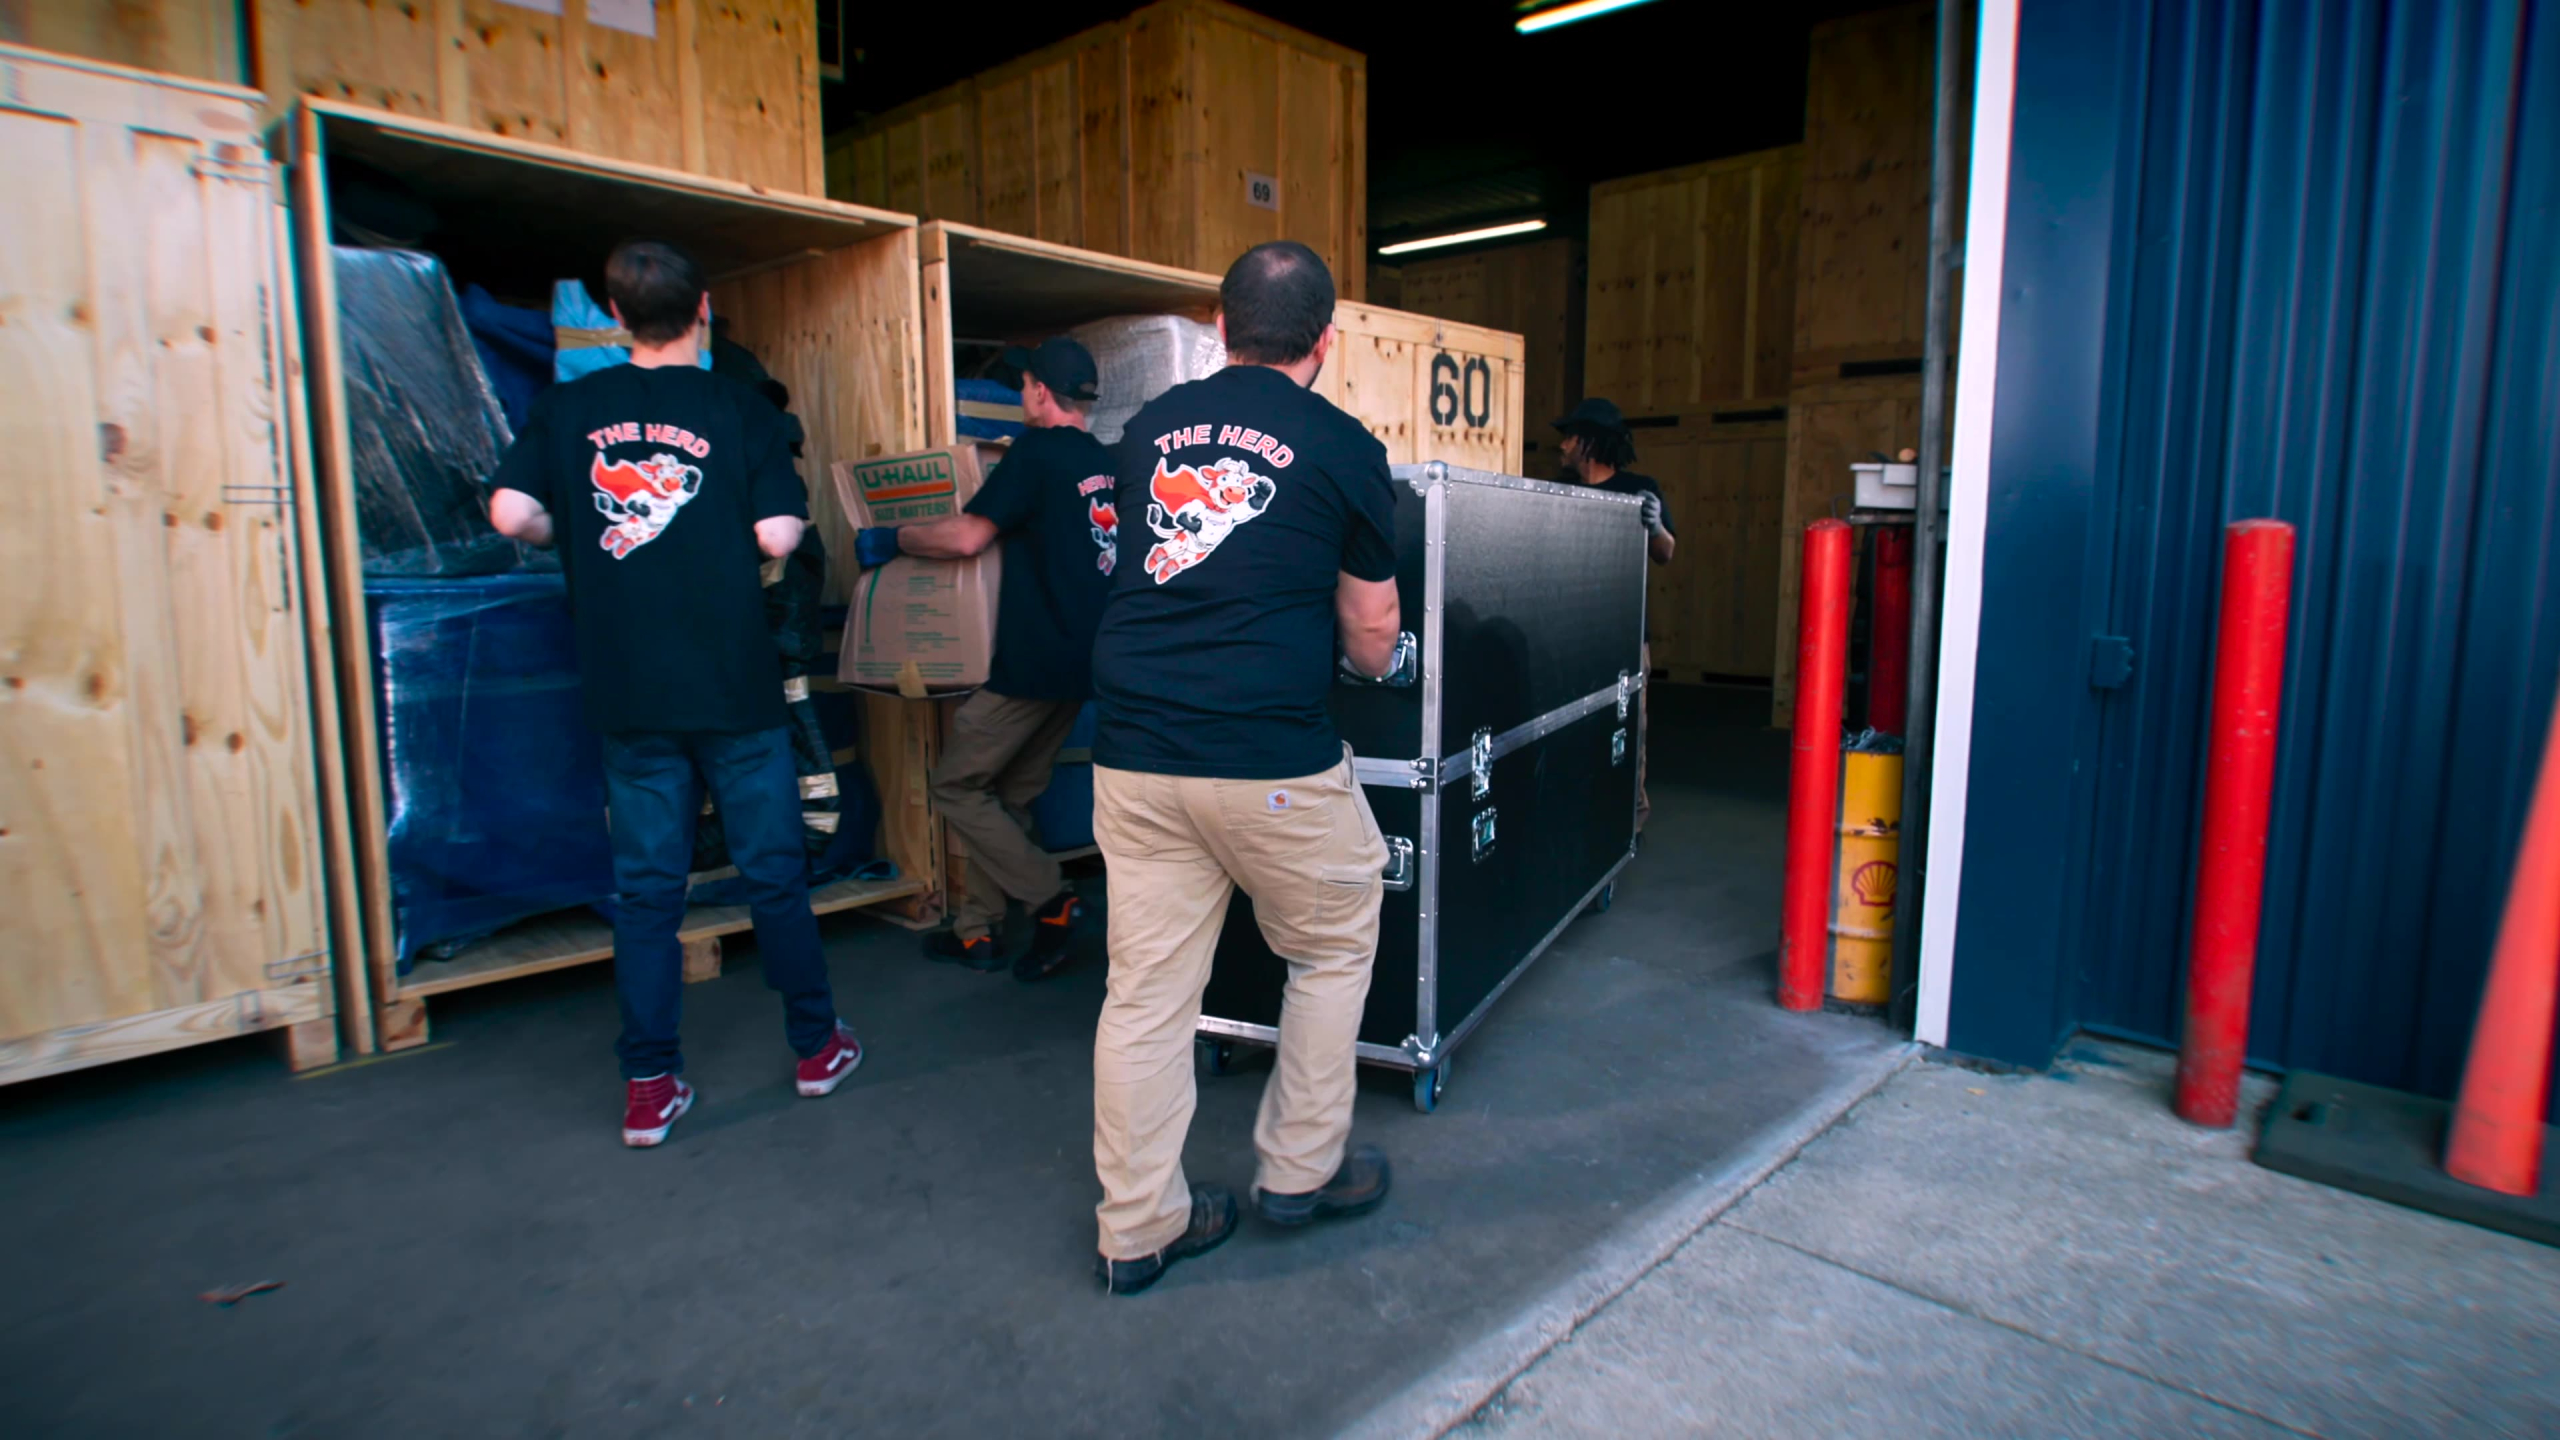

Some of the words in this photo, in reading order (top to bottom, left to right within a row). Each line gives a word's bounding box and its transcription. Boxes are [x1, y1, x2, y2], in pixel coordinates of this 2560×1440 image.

[1253, 181, 1271, 203] 69
[1430, 352, 1491, 428] 60
[586, 422, 642, 450] THE
[645, 423, 711, 458] HERD
[1154, 424, 1213, 455] THE
[1217, 424, 1295, 469] HERD
[861, 461, 948, 488] U-HAUL
